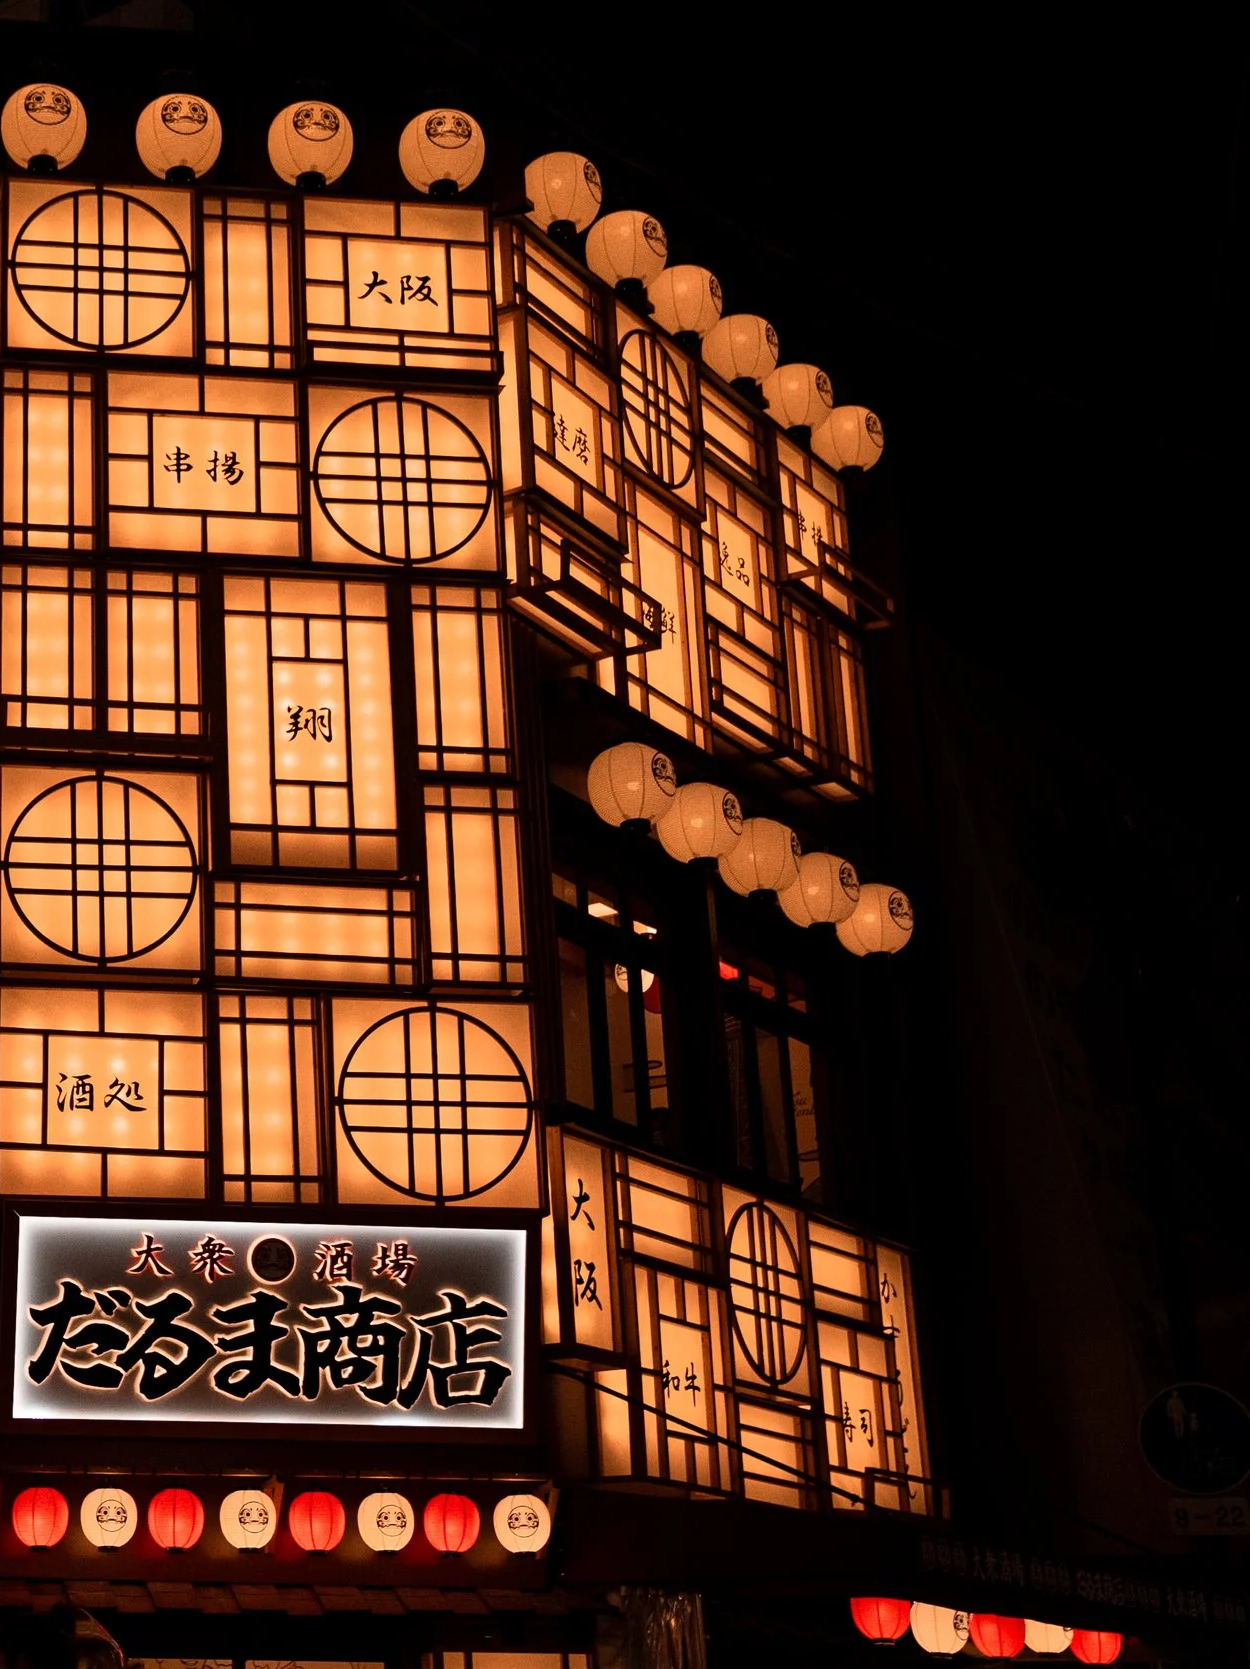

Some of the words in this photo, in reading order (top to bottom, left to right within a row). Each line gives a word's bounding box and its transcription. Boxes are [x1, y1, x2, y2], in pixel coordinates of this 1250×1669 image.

[357, 271, 439, 306] 大阪
[163, 446, 245, 485] 串揚
[286, 705, 333, 742] 翔
[55, 1072, 147, 1112] 酒処
[570, 1178, 603, 1311] 大阪
[27, 1279, 512, 1410] だるま商店
[661, 1359, 701, 1407] 和牛
[842, 1401, 874, 1448] 寿司
